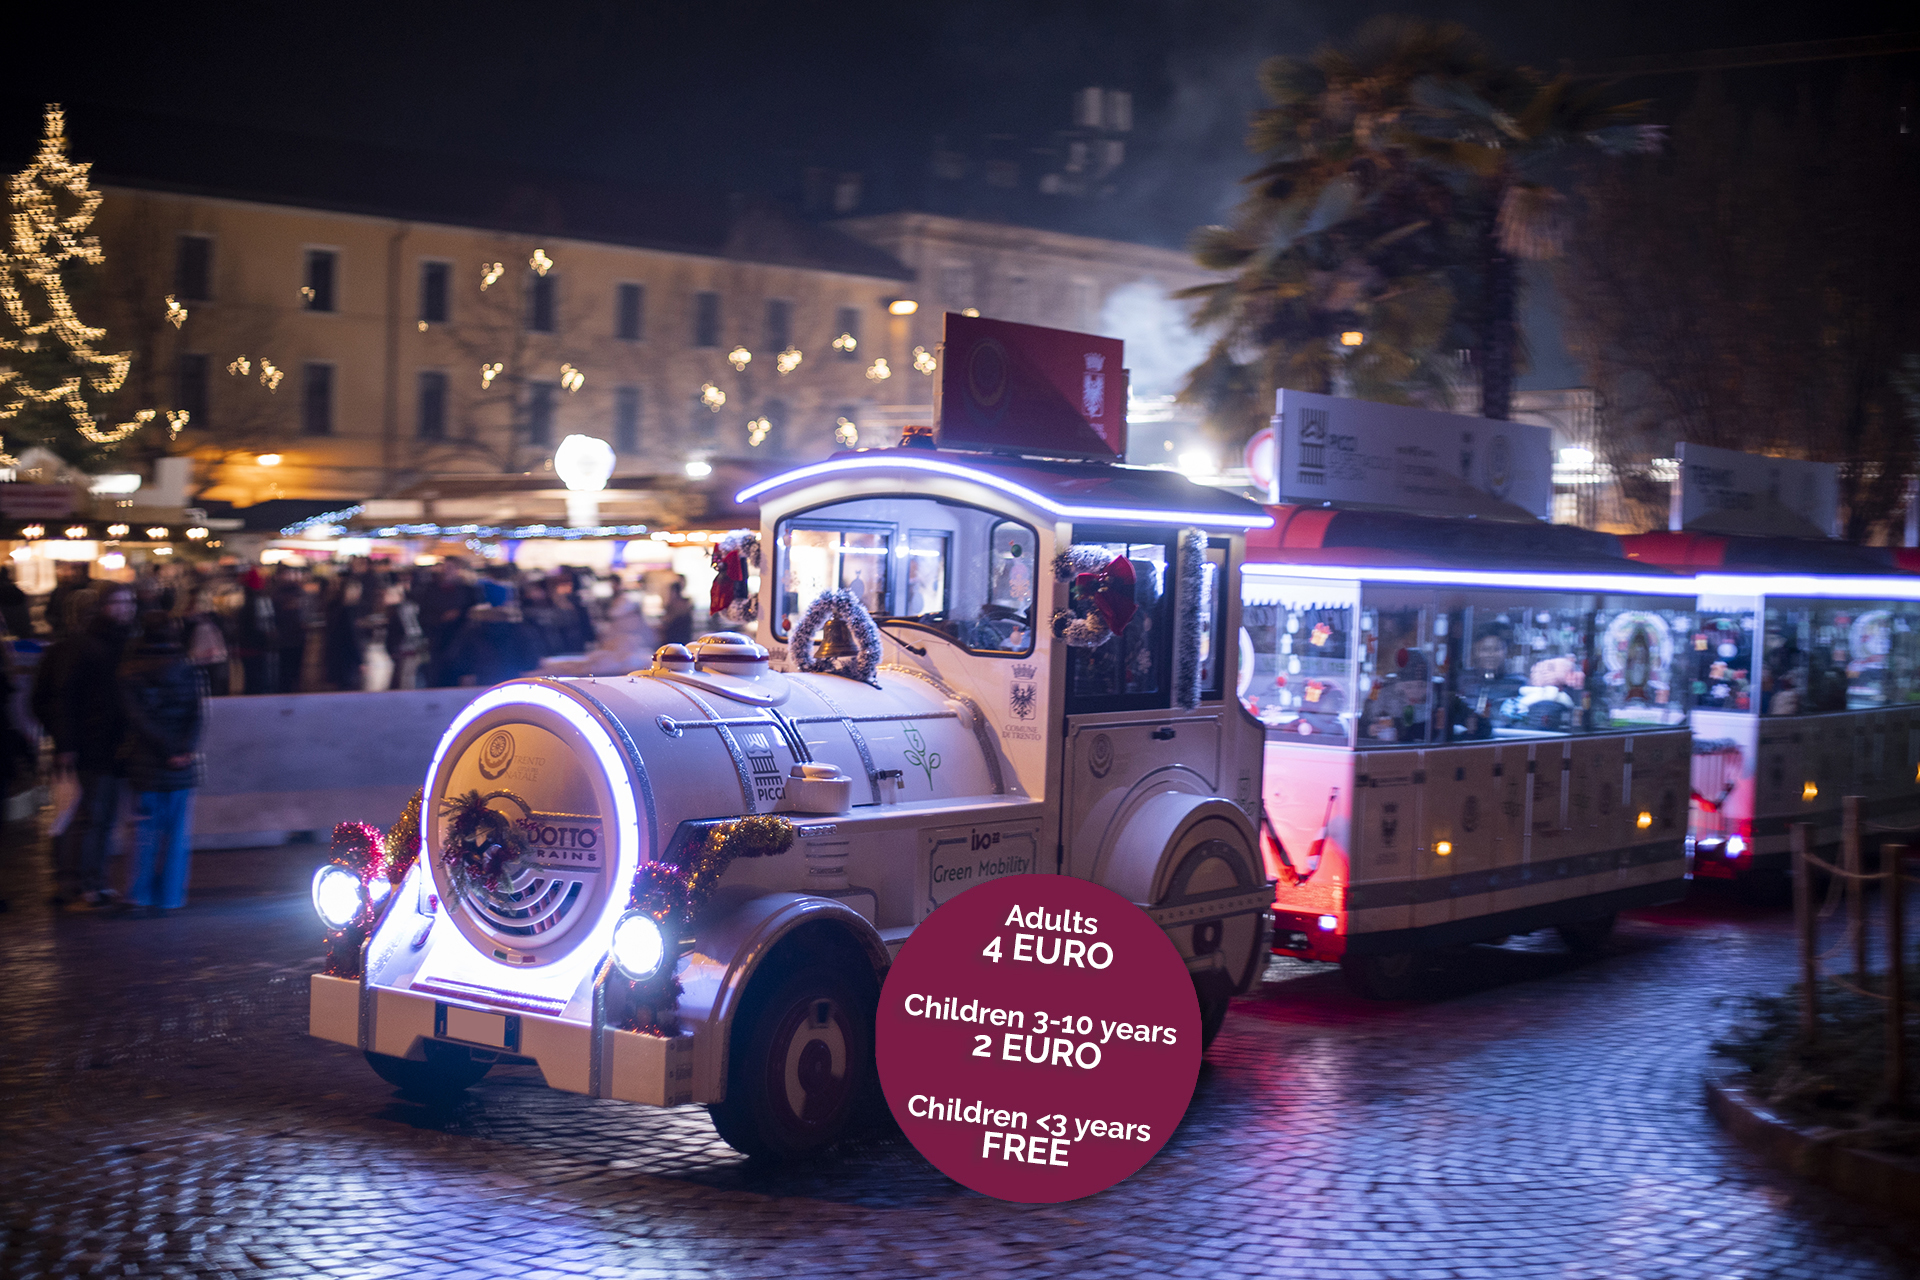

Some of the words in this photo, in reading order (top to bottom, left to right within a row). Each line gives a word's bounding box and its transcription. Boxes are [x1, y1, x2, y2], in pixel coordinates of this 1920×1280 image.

[1004, 724, 1039, 733] COMUNE
[1012, 732, 1041, 741] TRENTO
[514, 755, 546, 766] TRENTO
[505, 770, 538, 782] NATALE
[757, 787, 786, 801] PICCI
[527, 826, 597, 848] DOTTO
[536, 849, 597, 861] RAINS
[933, 864, 972, 883] Green
[978, 855, 1030, 877] Mobility
